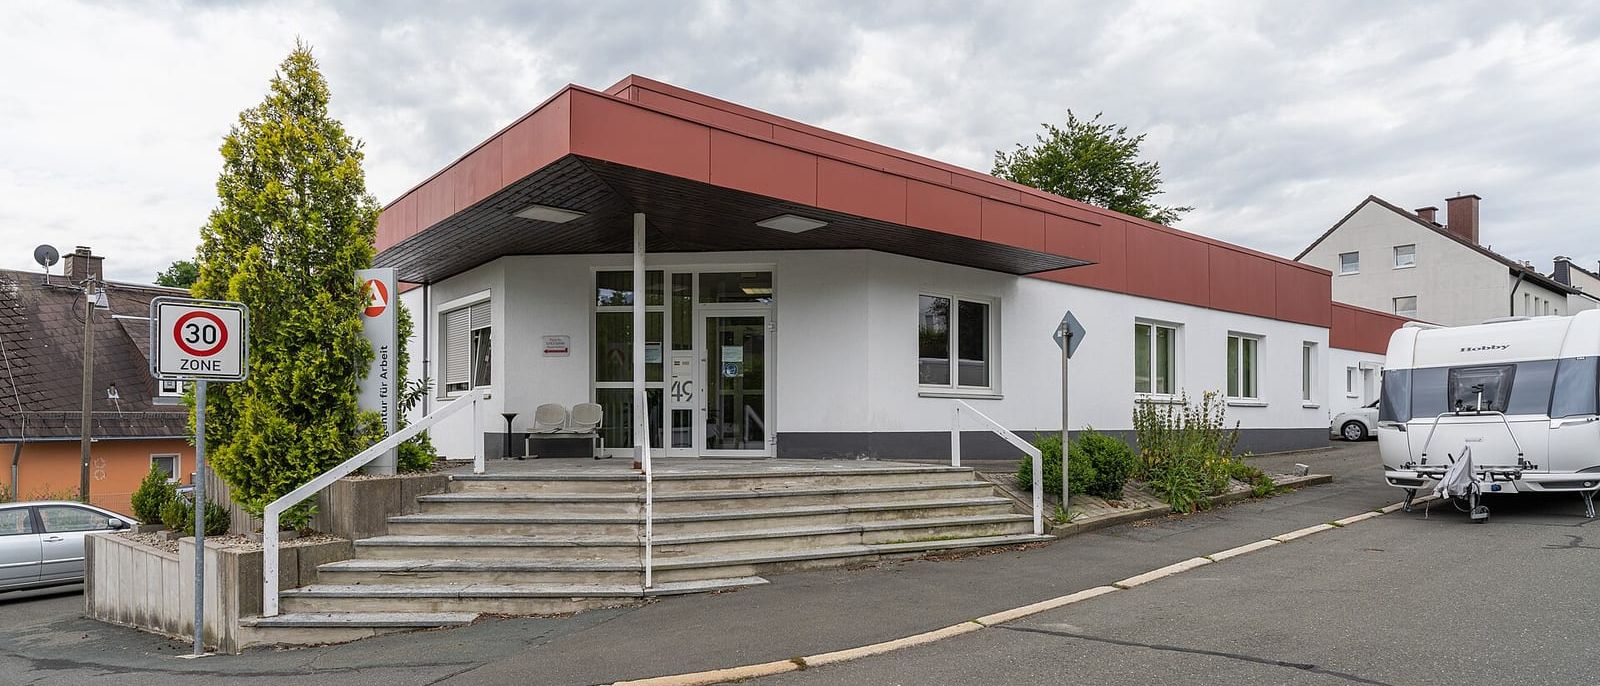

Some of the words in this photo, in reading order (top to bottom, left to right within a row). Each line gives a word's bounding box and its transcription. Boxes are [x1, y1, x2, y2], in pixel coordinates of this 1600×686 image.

[185, 323, 216, 344] 30
[1460, 344, 1511, 352] Hobby
[180, 359, 221, 371] ZONE
[380, 345, 388, 380] Arbeit
[380, 381, 388, 398] für
[671, 380, 693, 402] 49
